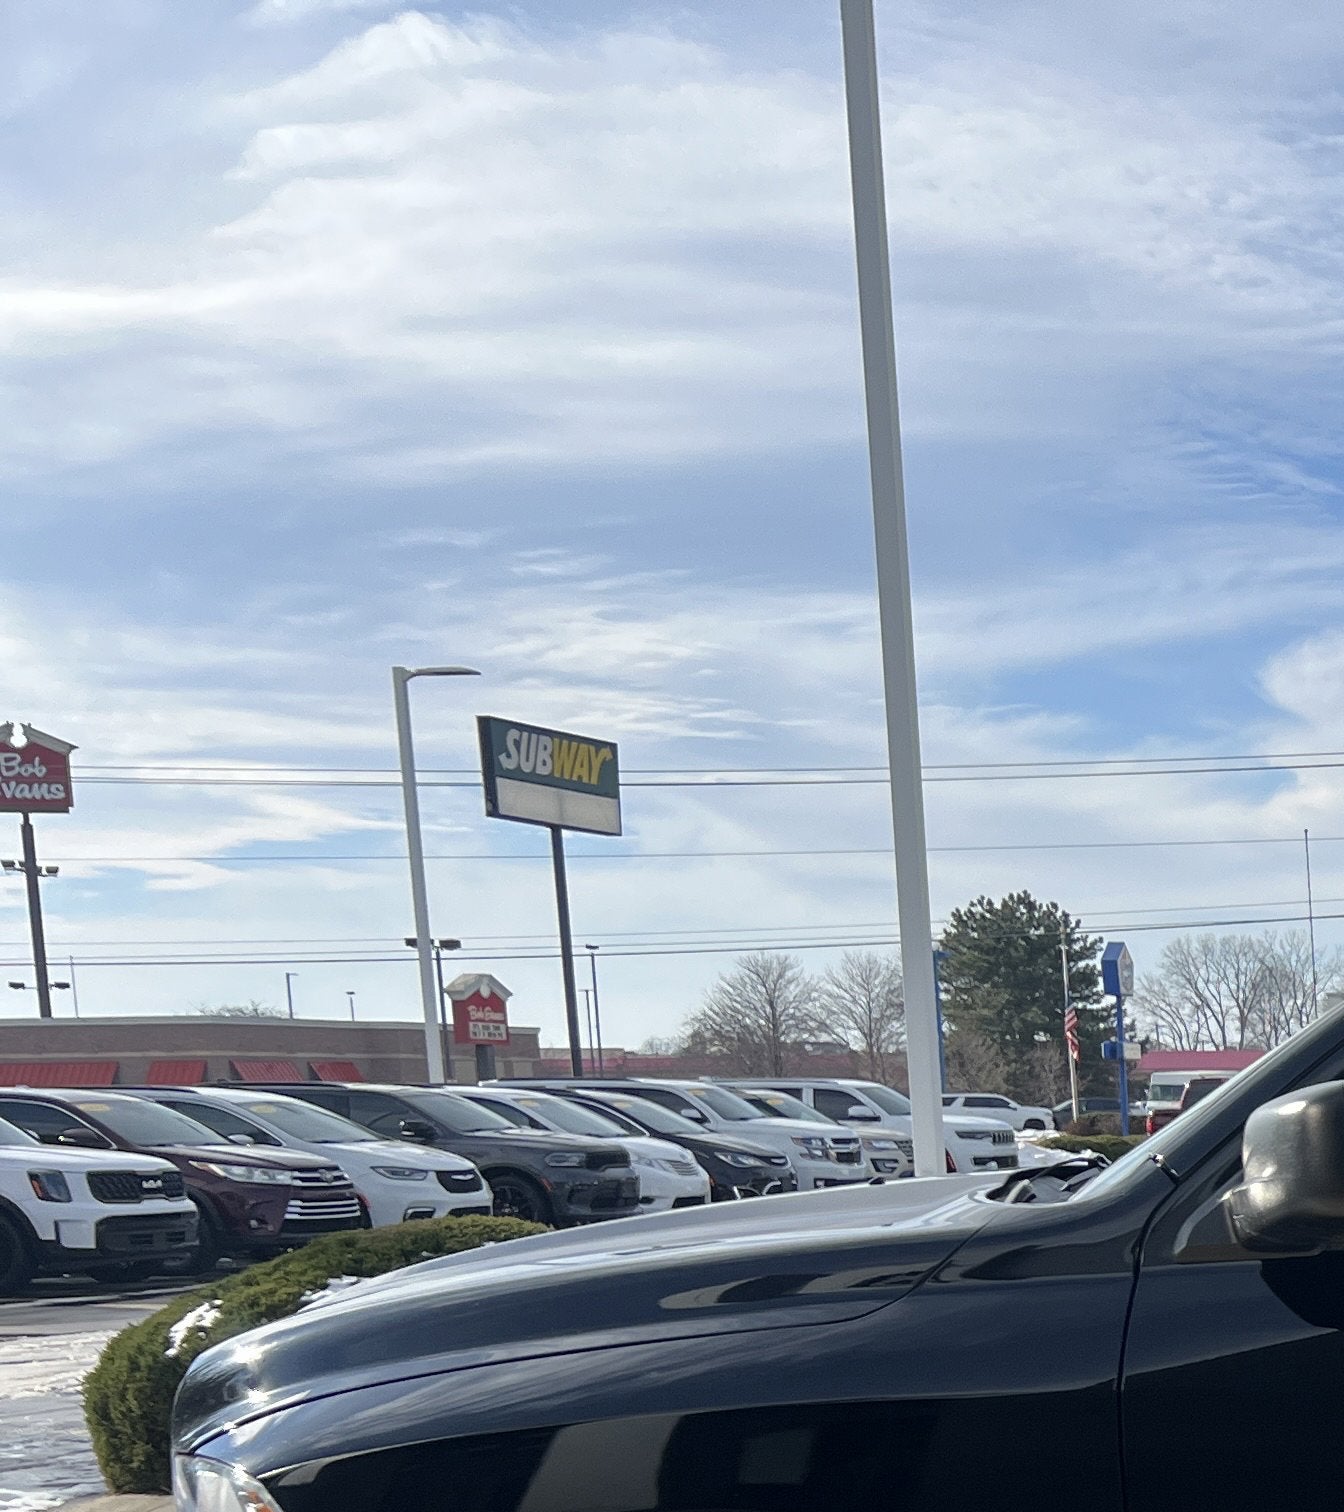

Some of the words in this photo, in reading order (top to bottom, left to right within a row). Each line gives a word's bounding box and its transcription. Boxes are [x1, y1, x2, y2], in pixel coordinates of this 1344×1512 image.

[0, 752, 47, 778] Bob
[498, 728, 614, 785] SUBWAY
[0, 781, 66, 800] vans
